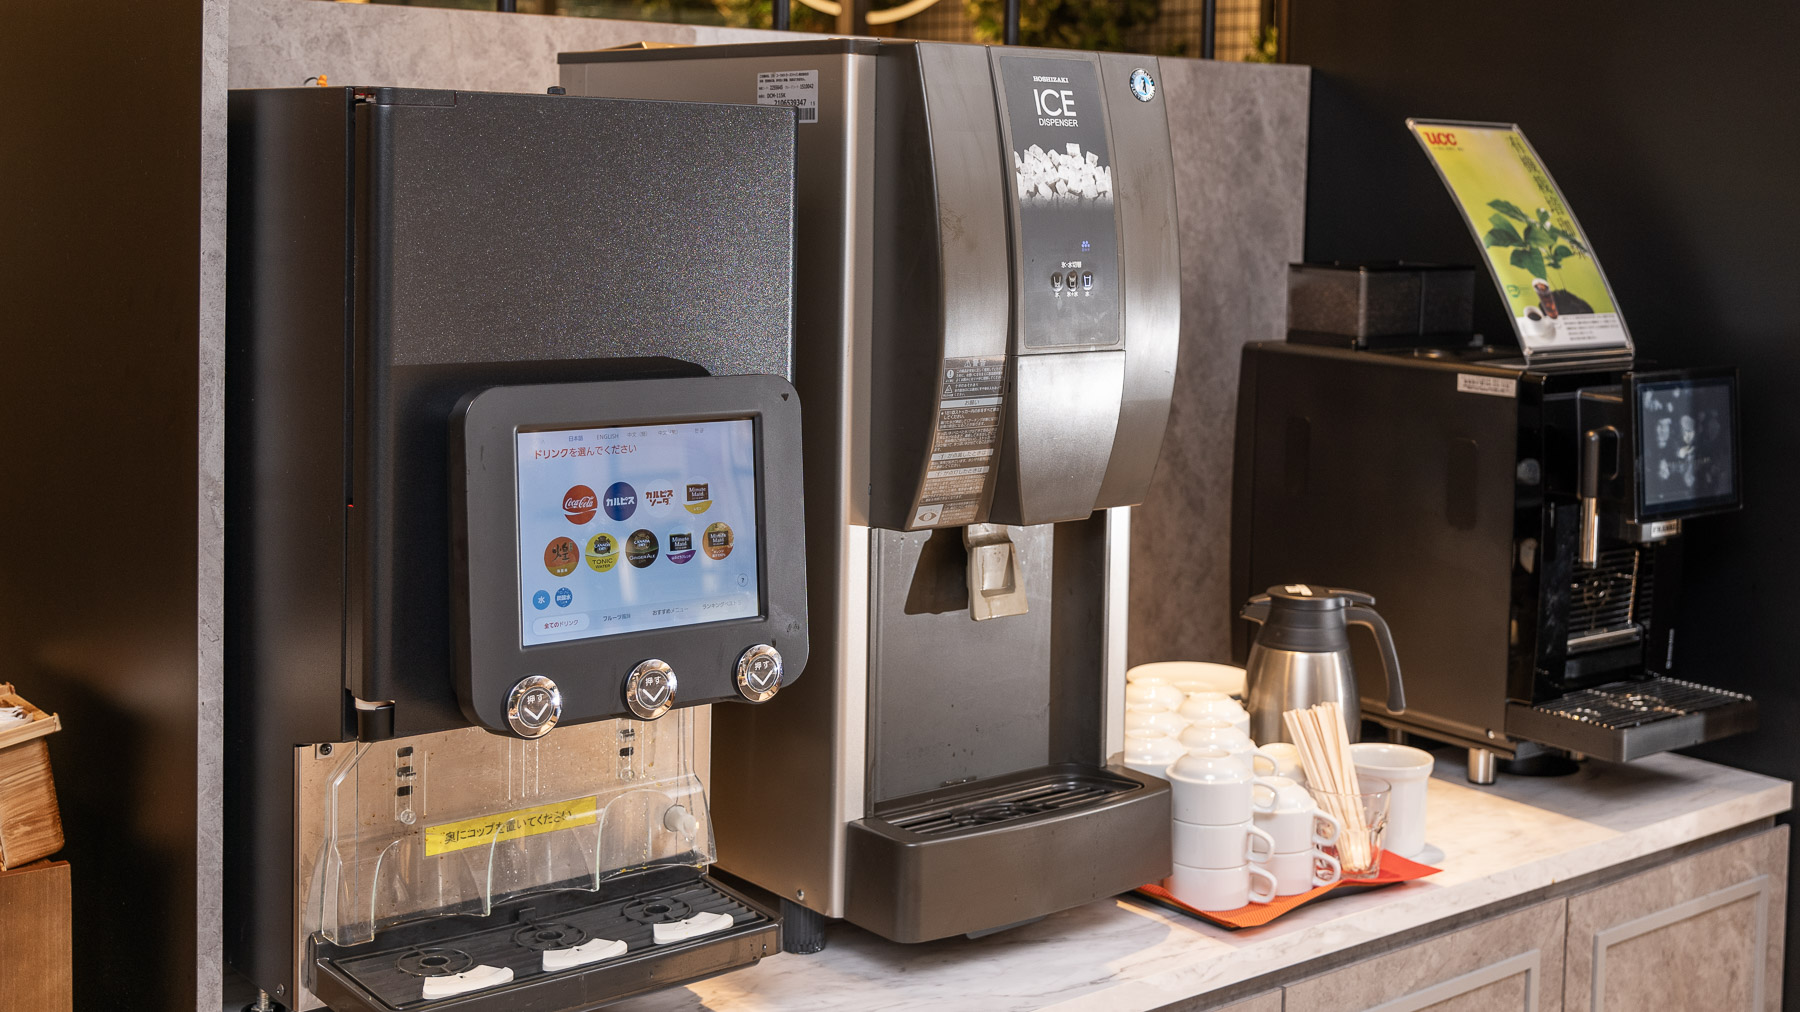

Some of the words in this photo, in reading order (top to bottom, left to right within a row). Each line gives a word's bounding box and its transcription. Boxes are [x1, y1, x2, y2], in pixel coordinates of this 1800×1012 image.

[1032, 75, 1069, 84] HOSHIZAKI
[1033, 88, 1077, 117] ICE
[1038, 117, 1079, 127] DISPENSER
[535, 444, 638, 460] ドリンクを選んでください
[645, 489, 674, 499] カルピス
[606, 496, 635, 507] カルピス
[649, 498, 670, 507] ソーダ
[537, 595, 546, 604] 水
[652, 607, 689, 616] おすすめメニュー
[543, 619, 579, 630] 全てのドリンク
[754, 660, 769, 672] 押す
[645, 675, 662, 687] 押す
[526, 692, 544, 704] 押す
[445, 809, 573, 845] 奥にコップを置いてください
